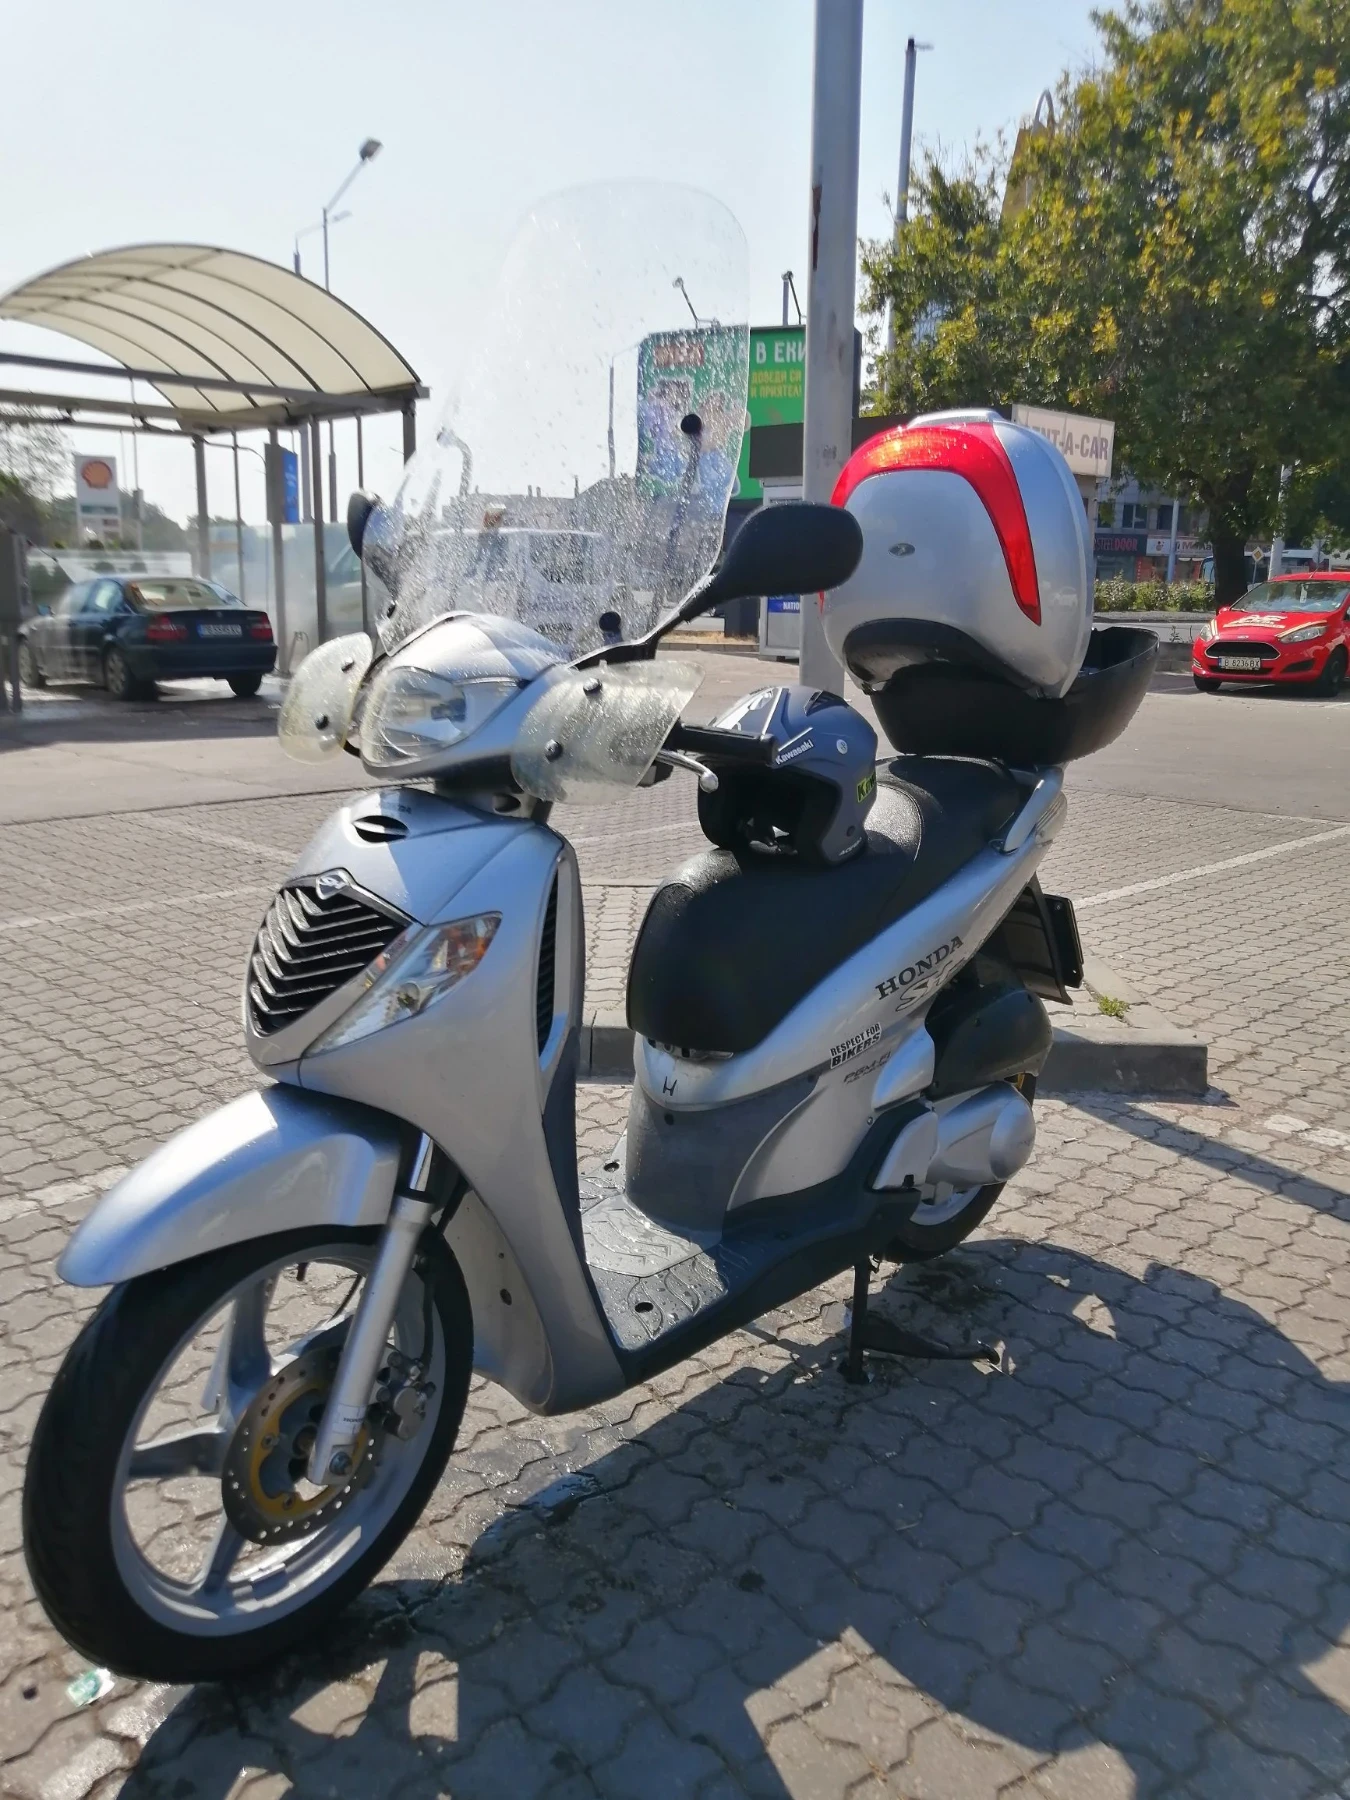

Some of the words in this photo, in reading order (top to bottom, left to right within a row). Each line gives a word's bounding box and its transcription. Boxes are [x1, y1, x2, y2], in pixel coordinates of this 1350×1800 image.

[775, 739, 814, 765] Kawasaki
[875, 935, 964, 1000] HONDA
[830, 1032, 865, 1057] RESPECT
[865, 1023, 881, 1038] FOR
[831, 1032, 881, 1068] BIKERS
